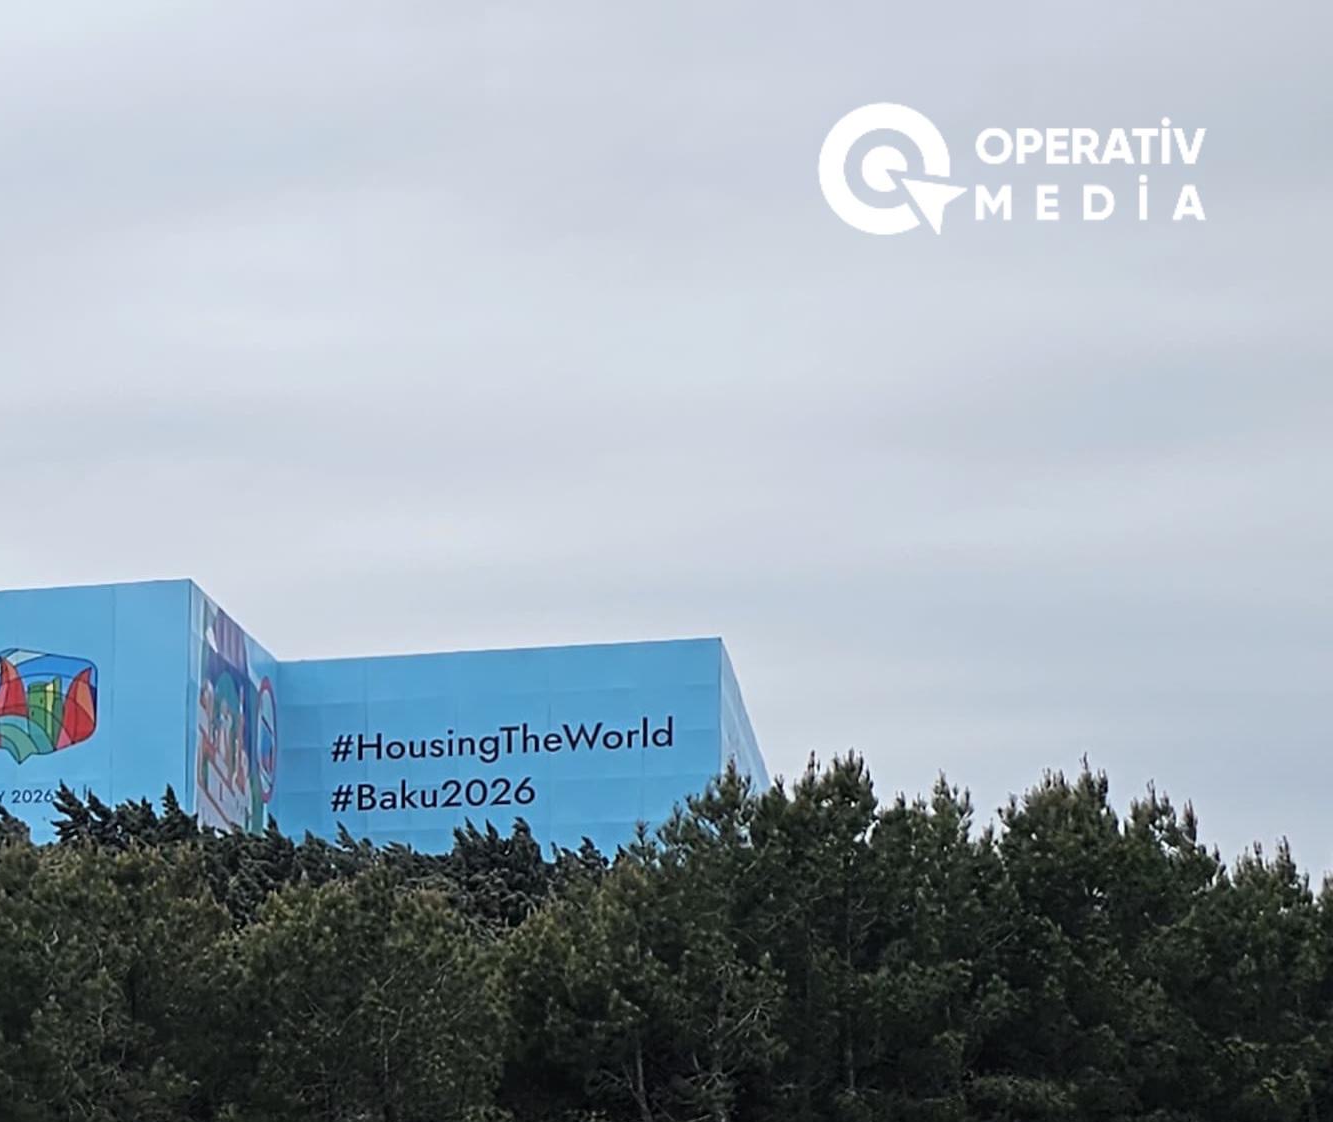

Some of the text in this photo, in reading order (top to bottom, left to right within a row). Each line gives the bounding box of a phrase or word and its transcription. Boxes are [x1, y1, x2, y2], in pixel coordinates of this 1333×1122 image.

[331, 716, 673, 763] #HousingTheWorld
[12, 789, 54, 803] 2026
[331, 778, 535, 812] #Baku2026
